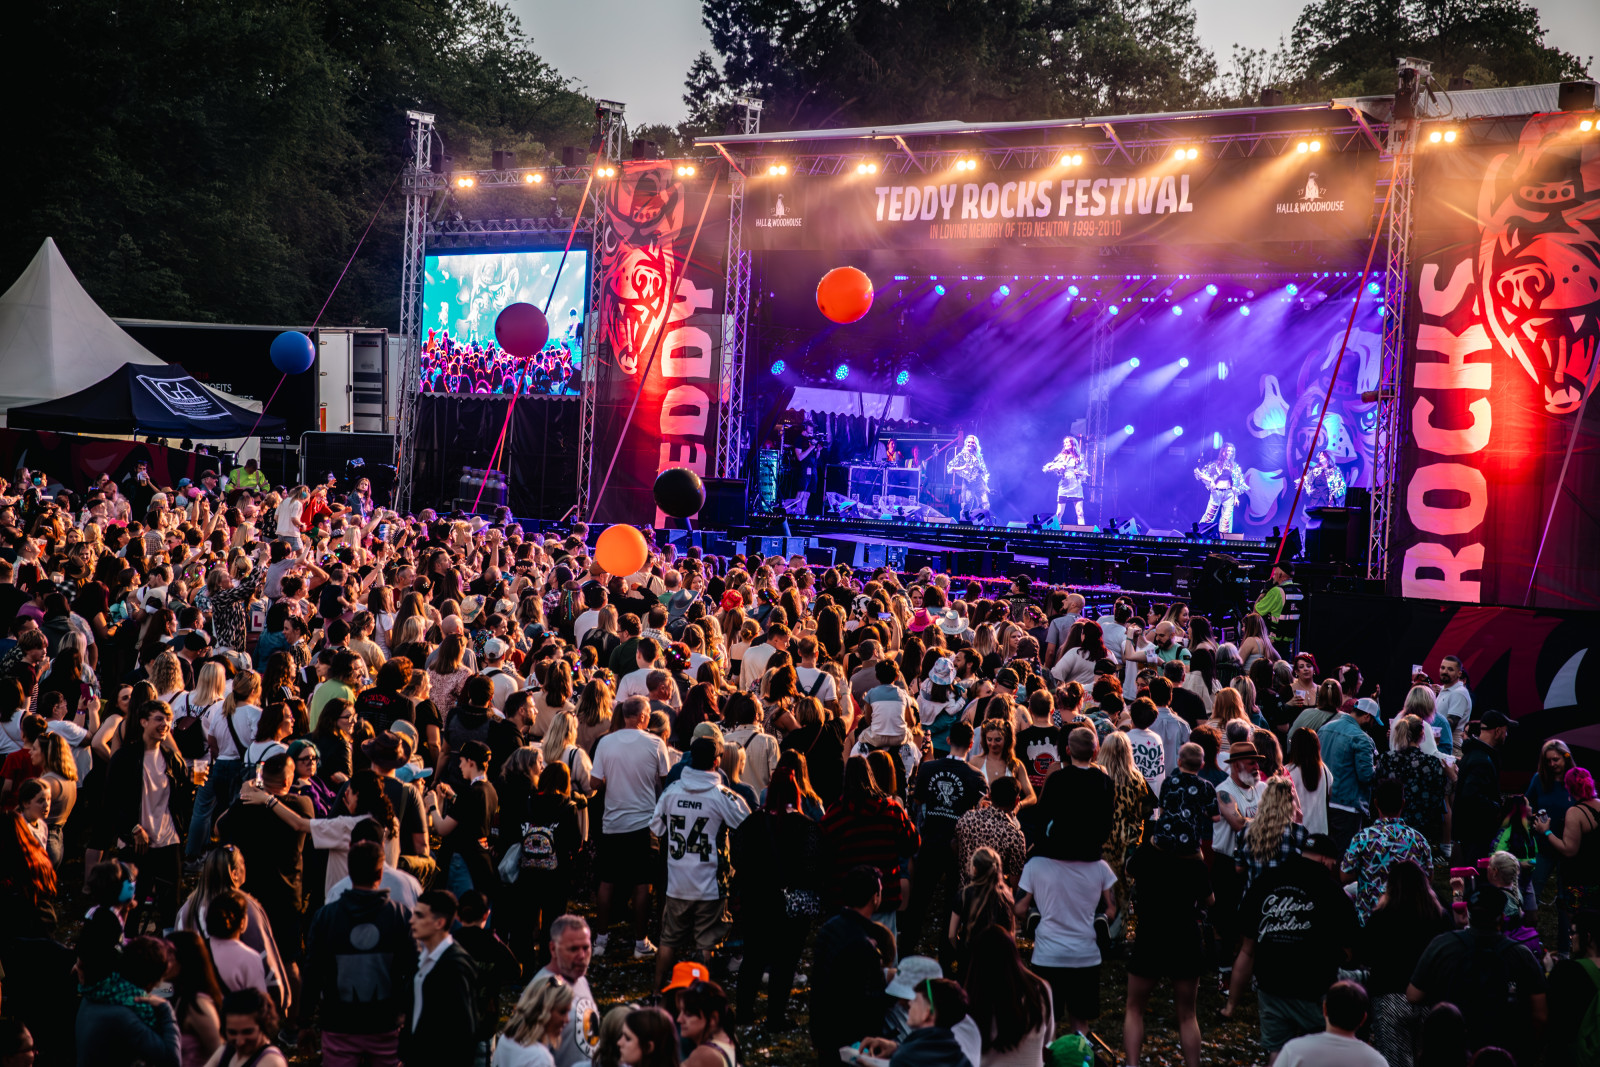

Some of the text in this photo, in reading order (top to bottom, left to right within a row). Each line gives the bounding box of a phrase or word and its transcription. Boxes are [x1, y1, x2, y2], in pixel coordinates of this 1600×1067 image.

[875, 174, 1193, 221] TEDDY ROCKS FESTIVAL
[1300, 201, 1344, 213] WOODHOUSE
[772, 217, 802, 227] WOODHOUSE
[930, 220, 1122, 240] IN LOVING MEMORY OF TED NEWTON 1999-2010
[1401, 257, 1493, 604] ROCKS
[254, 615, 262, 627] L
[946, 771, 964, 796] THEORY
[677, 799, 702, 810] CENA
[670, 814, 712, 862] 54
[1262, 894, 1314, 917] Caffeine
[1258, 914, 1312, 943] Gasoline
